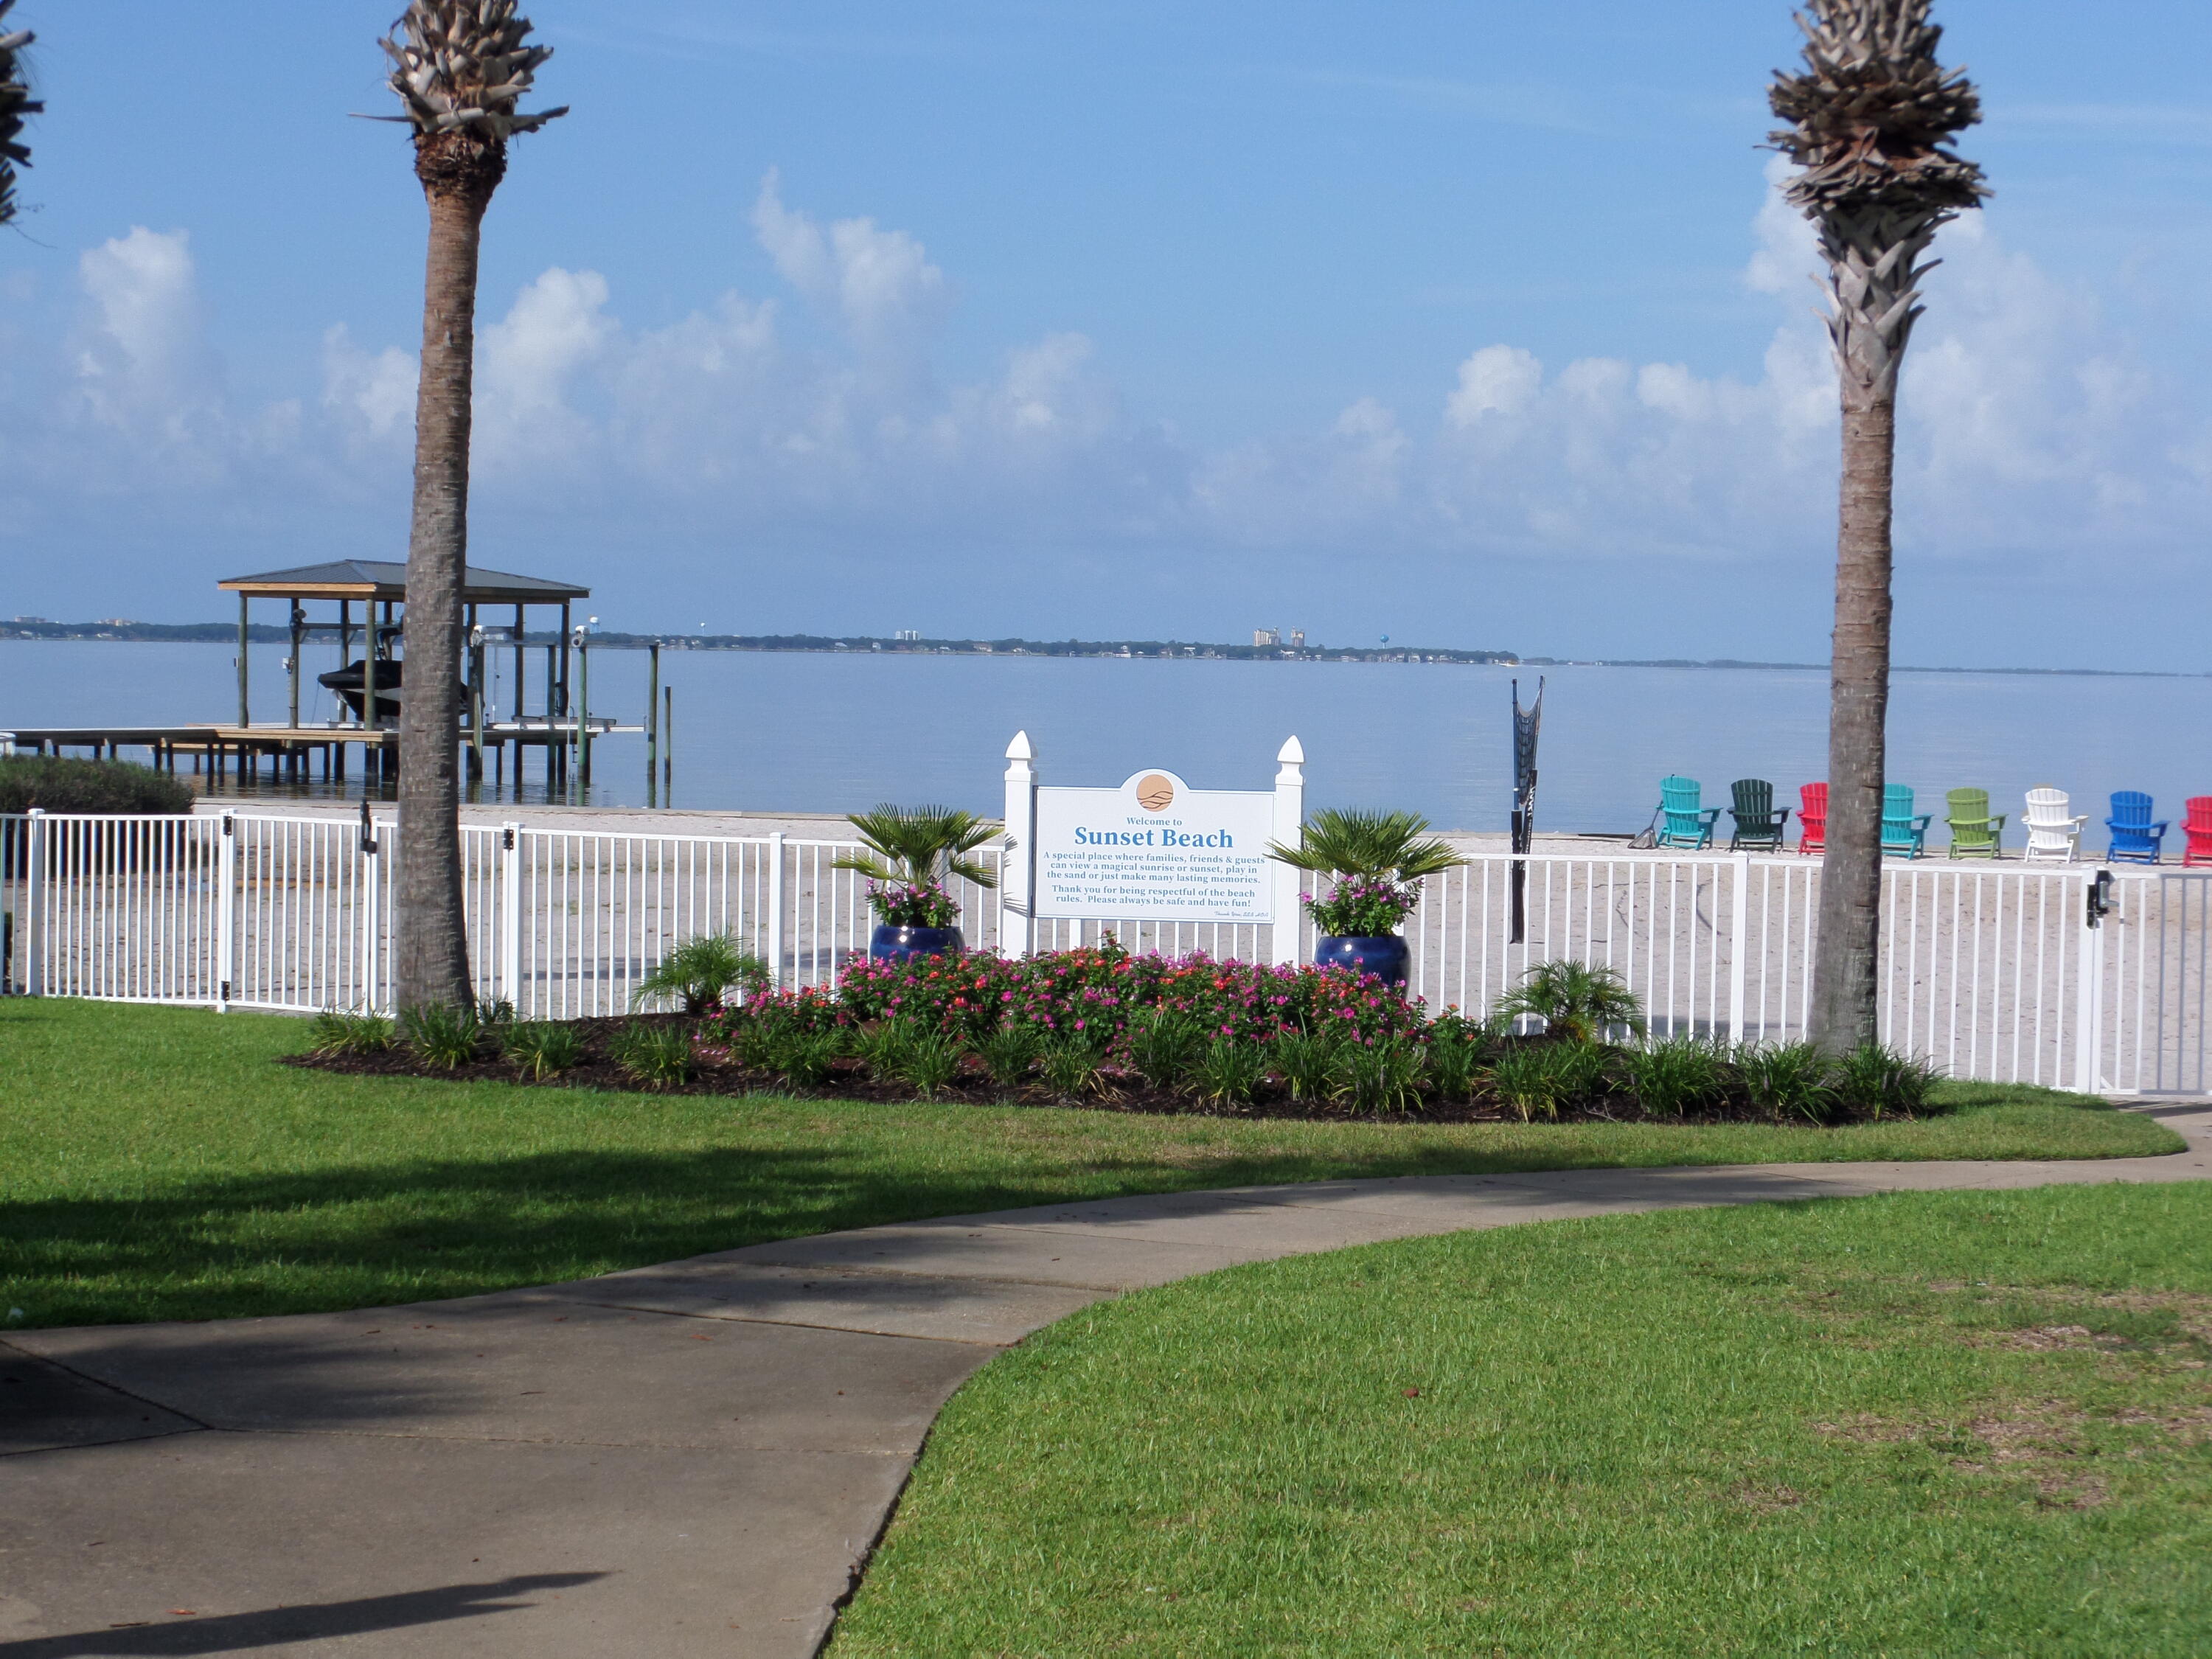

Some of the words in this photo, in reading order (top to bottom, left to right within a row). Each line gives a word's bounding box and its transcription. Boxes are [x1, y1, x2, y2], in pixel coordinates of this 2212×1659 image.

[1127, 817, 1170, 826] Welcome
[1074, 827, 1155, 846] Sunset
[1161, 829, 1234, 848] Beach
[1043, 851, 1050, 859] A
[1052, 851, 1085, 861] special
[1088, 852, 1113, 862] place
[1115, 853, 1144, 861] where
[1146, 853, 1187, 863] families,
[1189, 855, 1223, 863] friends
[1235, 857, 1265, 865] guests
[1070, 861, 1091, 869] view
[1101, 863, 1137, 872] magical
[1140, 863, 1175, 872] sunrise
[1189, 866, 1223, 874] sunset,
[1225, 866, 1246, 876] play
[1248, 866, 1257, 874] in
[1047, 870, 1062, 878] the
[1099, 872, 1119, 882] just
[1149, 874, 1174, 883] many
[1177, 874, 1208, 884] lasting
[1211, 876, 1261, 884] memories.
[1052, 885, 1082, 893] Thank
[1084, 887, 1101, 895] you
[1103, 886, 1117, 894] for
[1119, 886, 1146, 897] being
[1148, 888, 1195, 897] respectful
[1198, 888, 1208, 897] of
[1228, 889, 1255, 897] beach
[1056, 894, 1082, 902] rules.
[1119, 897, 1150, 906] always
[1166, 897, 1185, 905] safe
[1231, 899, 1251, 908] fun!
